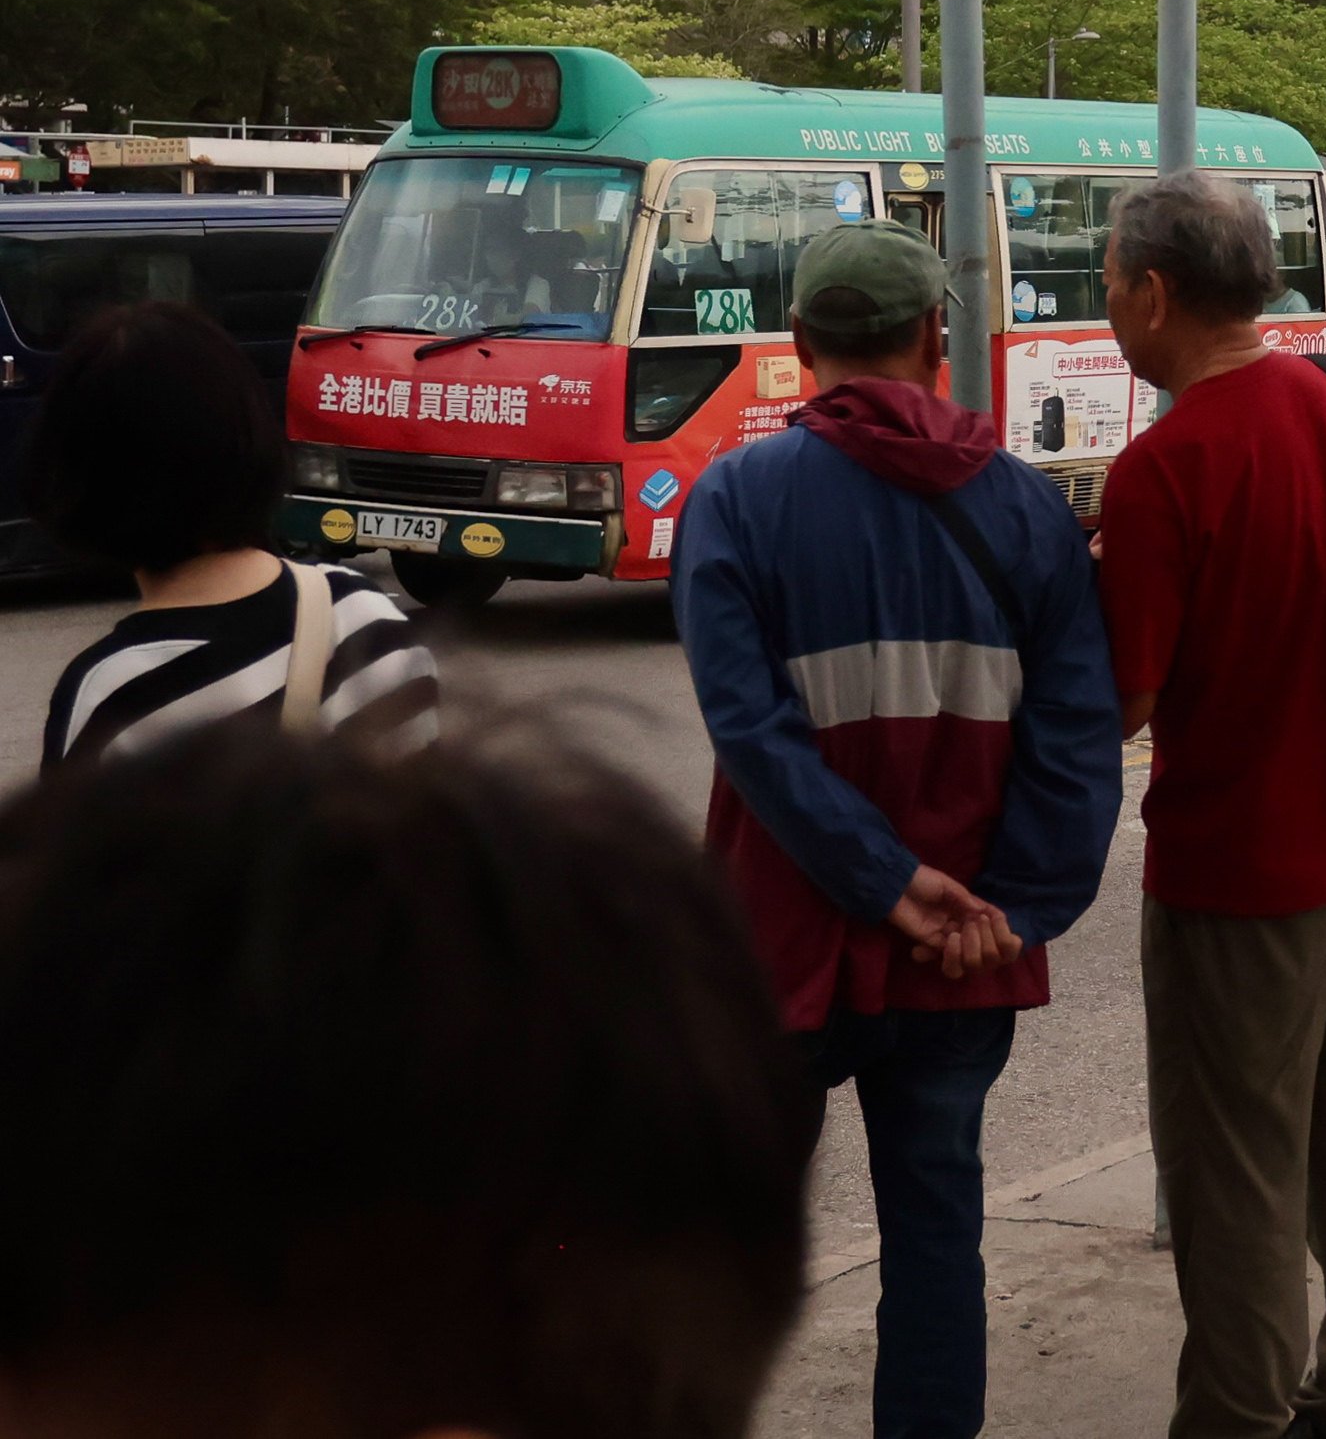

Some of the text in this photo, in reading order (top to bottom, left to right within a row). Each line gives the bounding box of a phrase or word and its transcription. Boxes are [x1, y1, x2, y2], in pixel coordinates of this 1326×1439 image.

[800, 128, 862, 152] PUBLIC
[864, 130, 912, 153] LIGHT
[984, 134, 1031, 155] SEATS
[318, 373, 529, 427] 全港比價 買貴就賠
[559, 379, 593, 395] 京东
[362, 515, 437, 540] LY 1743
